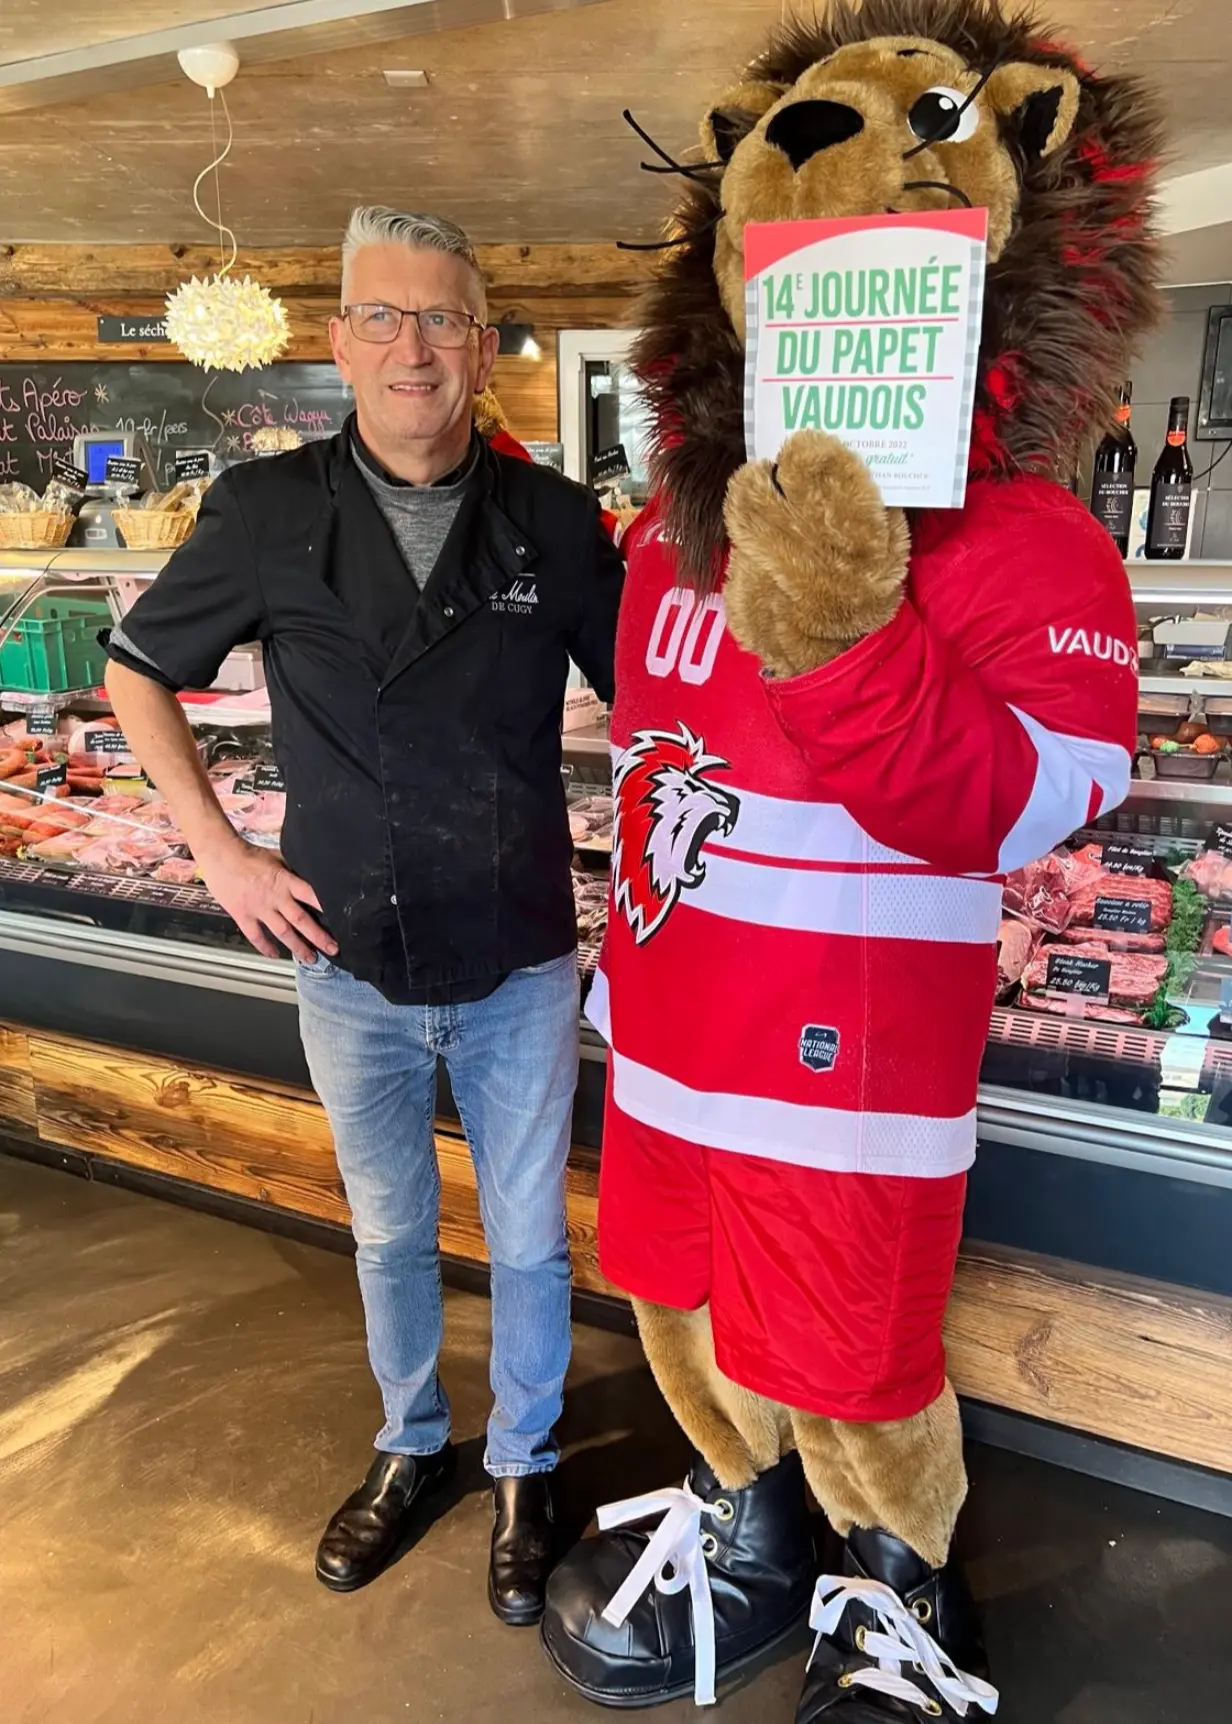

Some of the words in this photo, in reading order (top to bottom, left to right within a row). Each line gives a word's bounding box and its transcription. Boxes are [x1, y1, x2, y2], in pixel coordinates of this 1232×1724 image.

[803, 255, 963, 319] JOURNÉE
[120, 323, 136, 337] Le
[139, 322, 166, 337] séch
[776, 329, 822, 376] DU
[831, 325, 944, 376] PAPET
[22, 376, 88, 423] Apéro
[781, 383, 928, 431] VAUDOIS
[491, 601, 506, 612] DE
[507, 602, 533, 615] CUGY
[645, 586, 728, 687] 00
[801, 1039, 837, 1054] NATIONAL
[804, 1048, 832, 1062] LEAGUE
